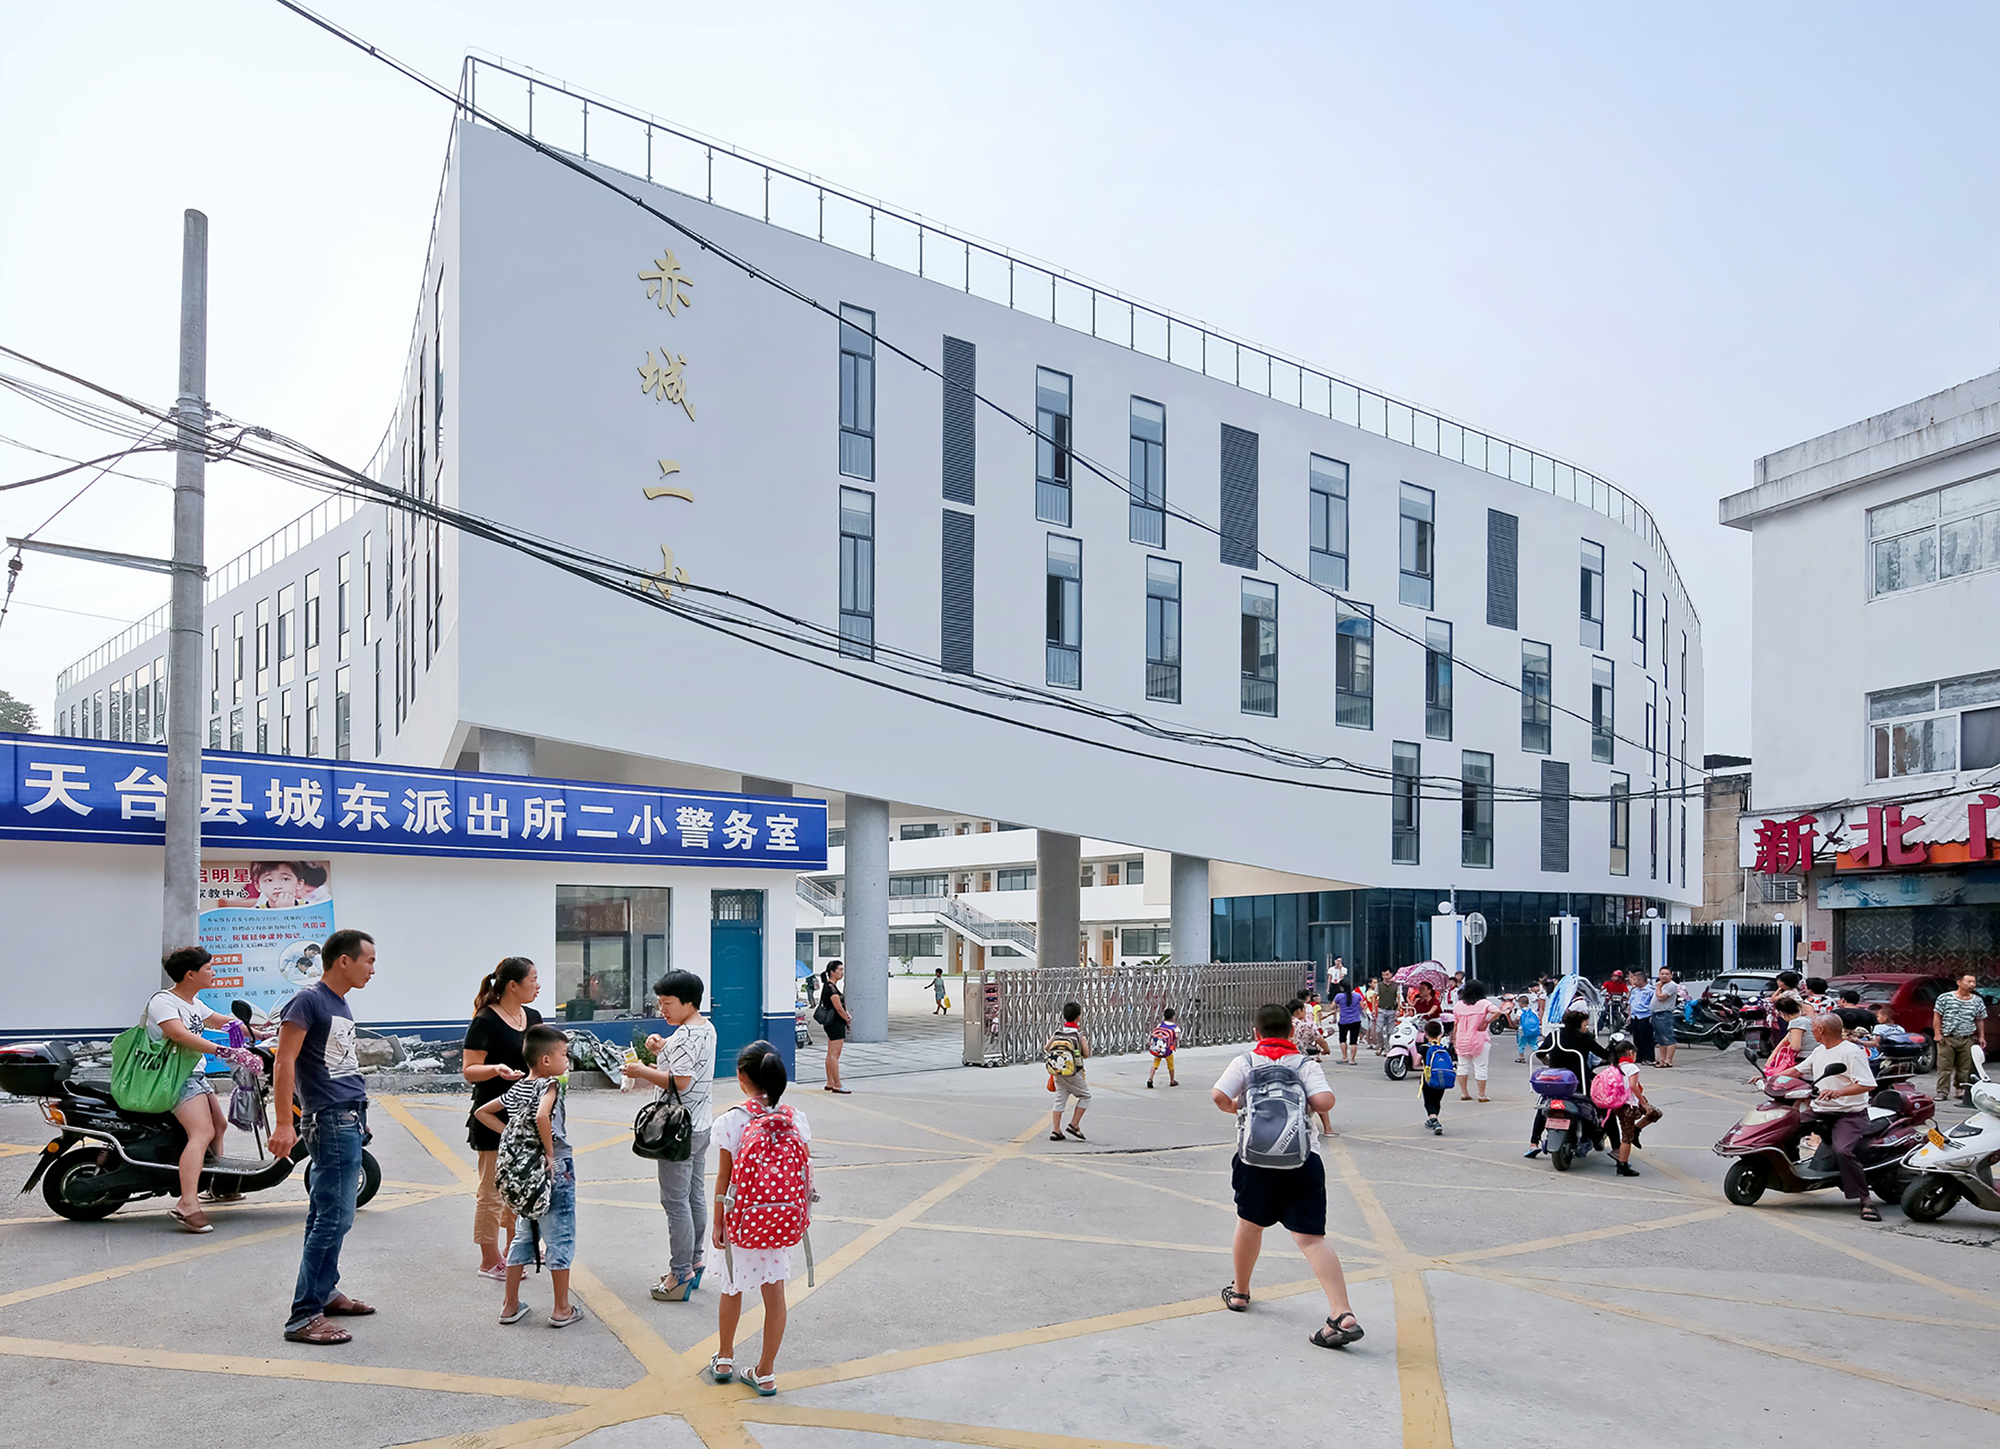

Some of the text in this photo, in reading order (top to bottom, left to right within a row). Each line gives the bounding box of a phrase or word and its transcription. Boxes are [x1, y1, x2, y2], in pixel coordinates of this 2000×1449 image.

[638, 247, 696, 600] 赤城二小
[23, 761, 800, 852] 天台县城东派出所二小警务室
